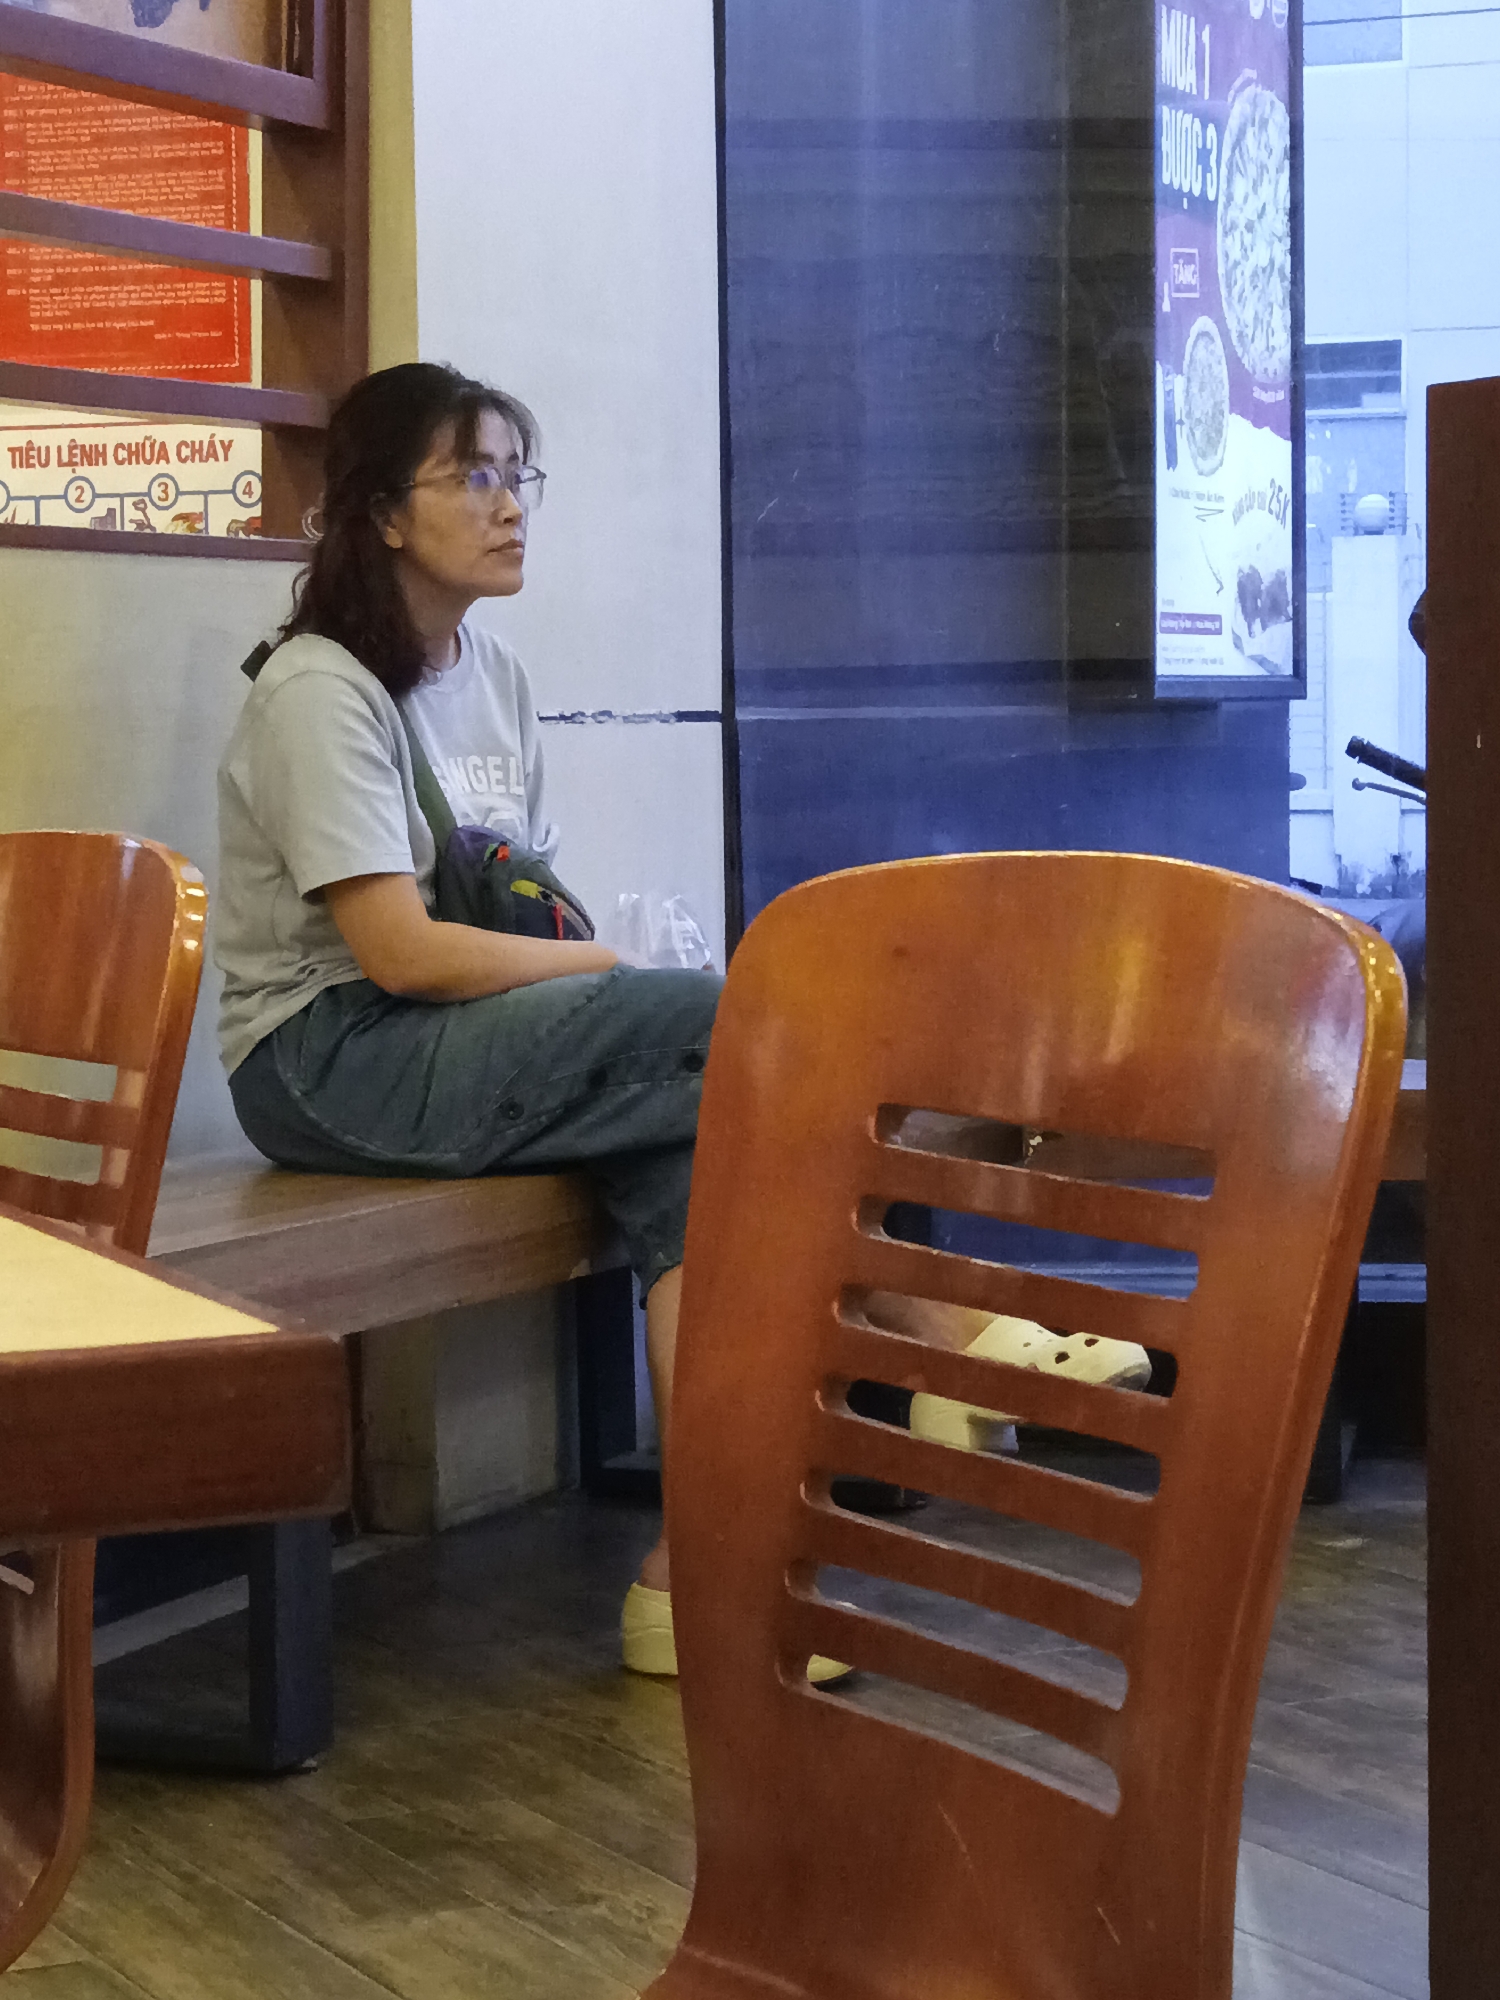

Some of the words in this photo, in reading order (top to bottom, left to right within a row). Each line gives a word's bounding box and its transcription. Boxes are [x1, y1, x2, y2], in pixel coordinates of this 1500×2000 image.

[1161, 4, 1197, 95] MUA
[1202, 24, 1210, 100] 1
[1206, 123, 1217, 201] 3
[7, 440, 51, 469] TIÊU
[56, 438, 108, 474] LỆNH
[113, 435, 171, 466] CHỮA
[176, 433, 234, 464] CHÁY
[74, 485, 86, 504] 2
[157, 481, 170, 502] 3
[242, 480, 254, 499] 4
